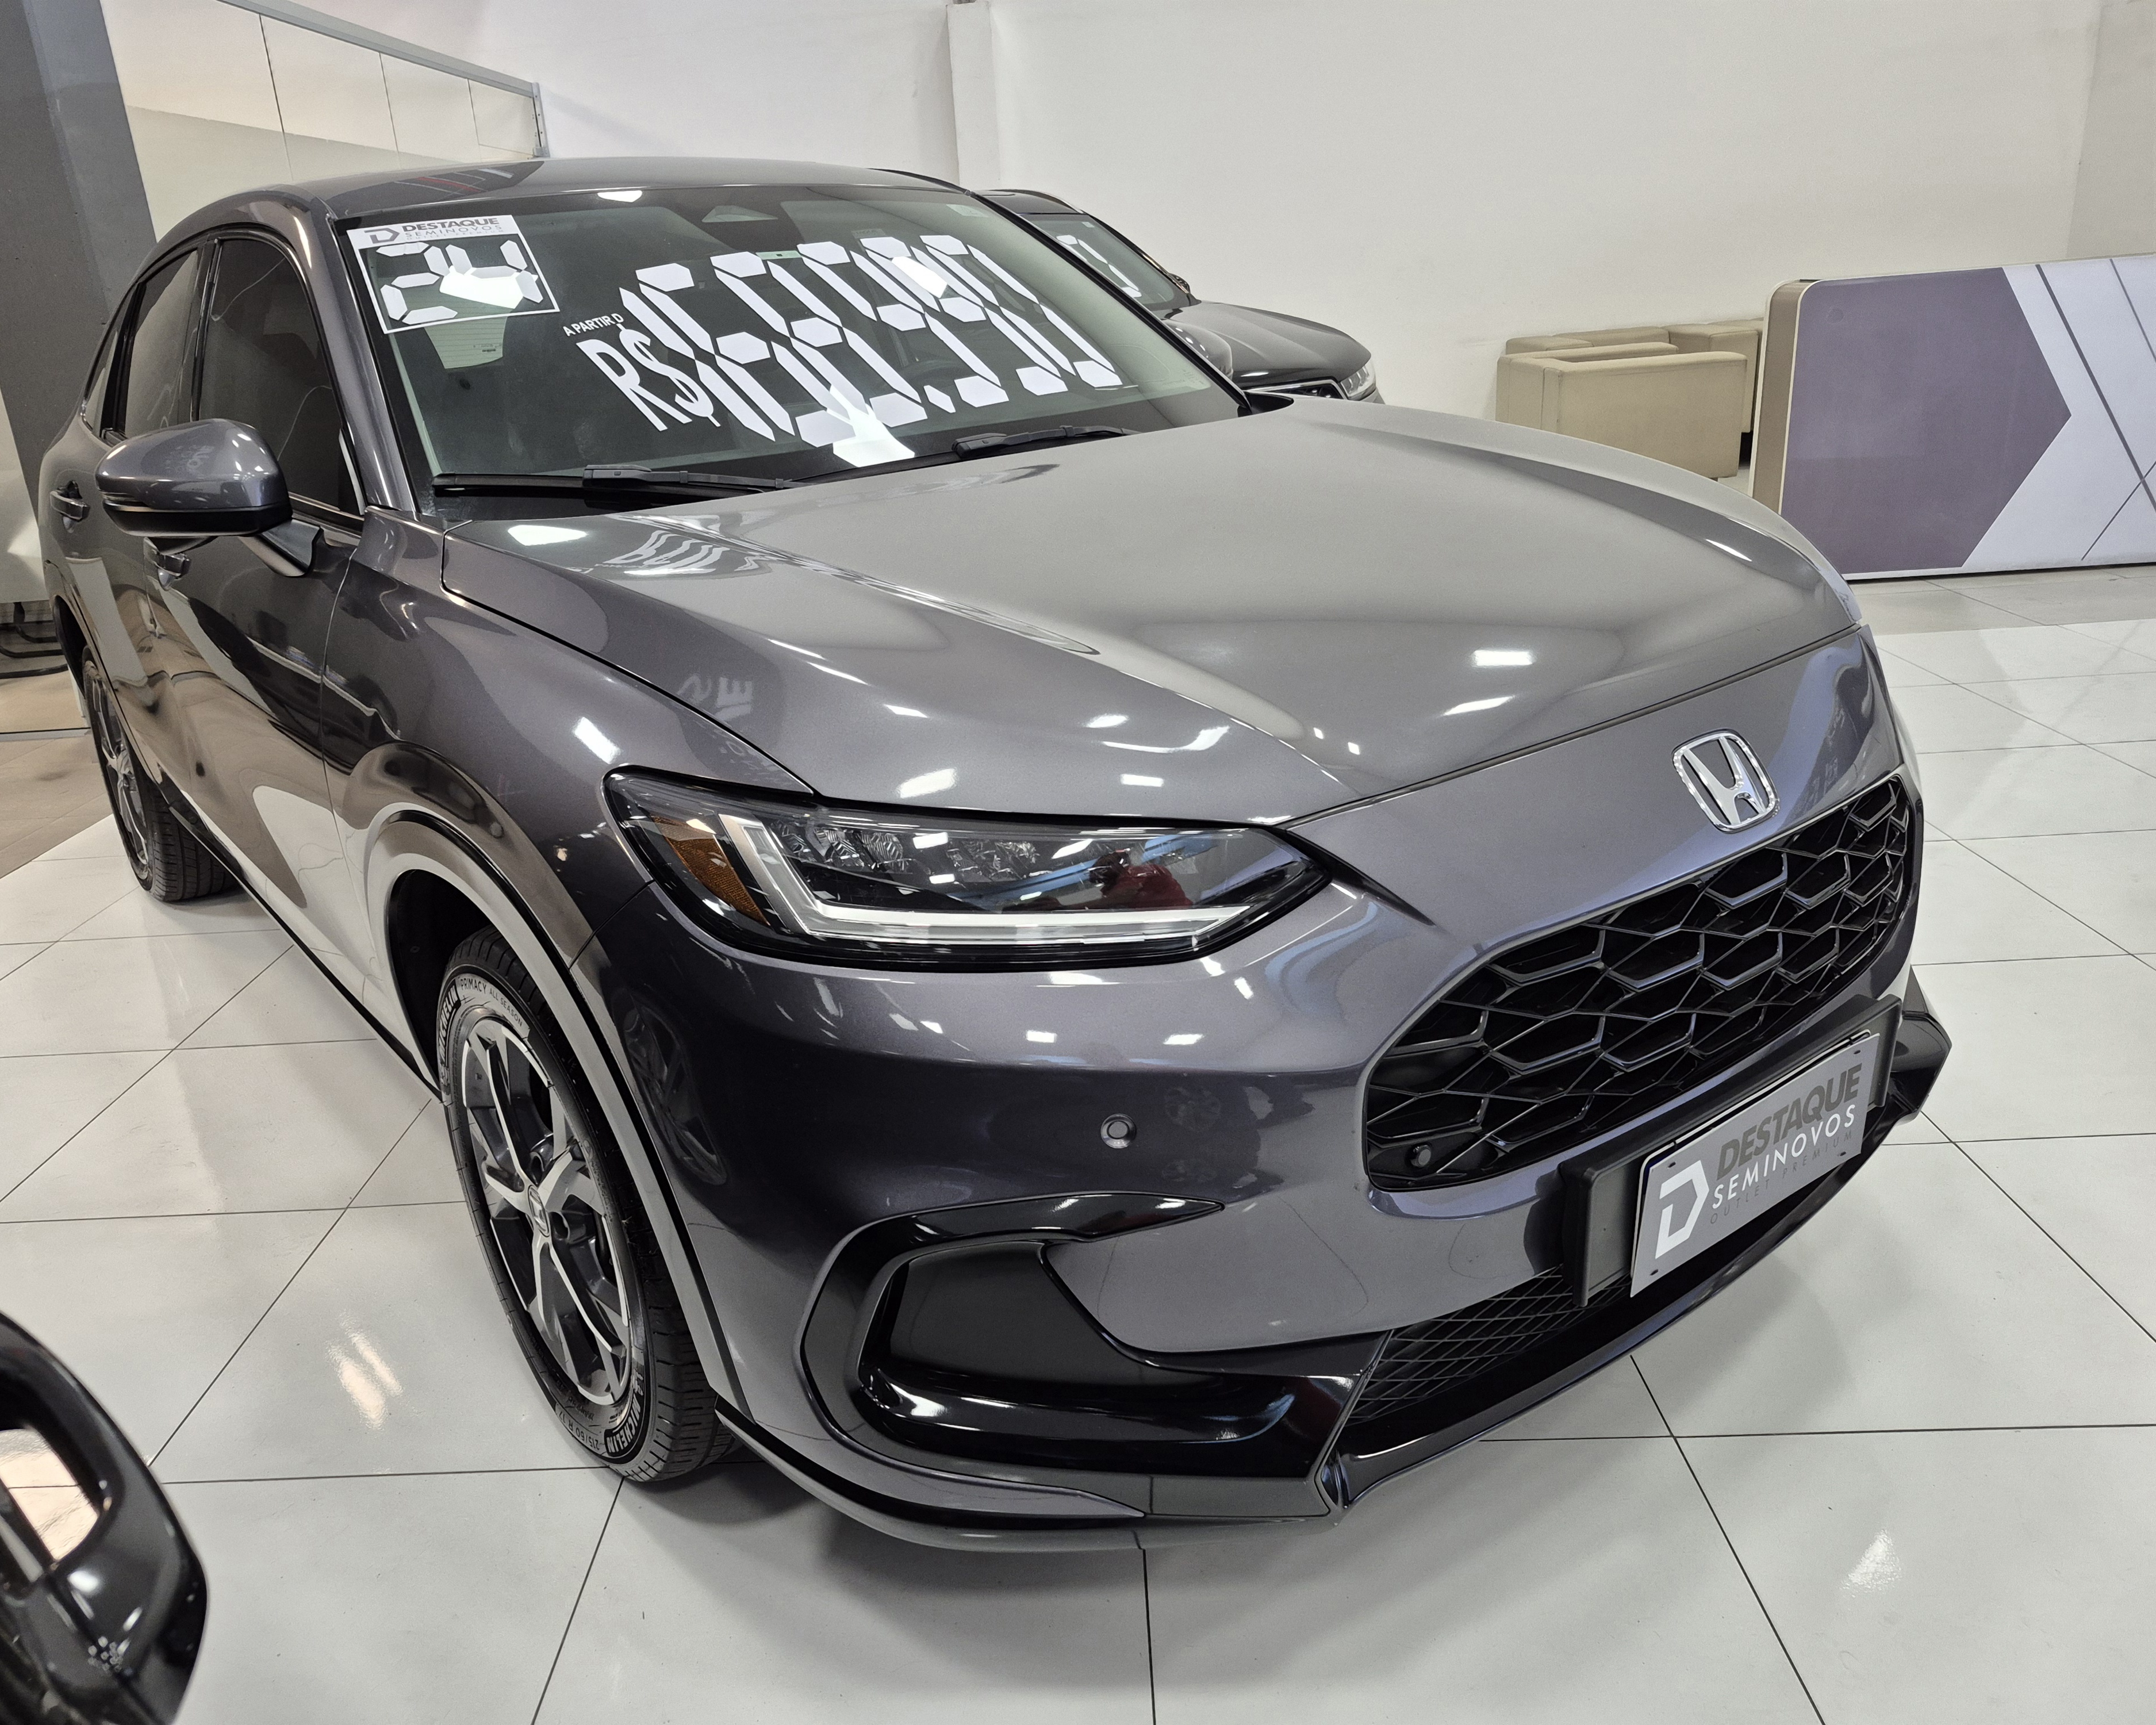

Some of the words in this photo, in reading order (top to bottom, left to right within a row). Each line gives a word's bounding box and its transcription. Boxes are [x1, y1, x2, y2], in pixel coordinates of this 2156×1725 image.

[401, 217, 500, 232] DESTAQUE
[405, 225, 502, 237] SEMINOVOS
[376, 240, 543, 325] 24
[562, 325, 577, 337] A
[570, 315, 616, 334] PARTIR
[576, 323, 721, 432] R$
[438, 984, 459, 1063] MICHELIN
[460, 978, 487, 994] PRIMACY
[489, 987, 500, 1001] ALL
[500, 998, 523, 1028] SEASON
[1716, 1063, 1862, 1180] DESTAQUE
[1710, 1179, 1770, 1224] OUTLET
[1782, 1130, 1852, 1179] PREMIUM
[1712, 1104, 1856, 1209] SEMINOVOS
[558, 1410, 566, 1424] 17
[568, 1420, 574, 1432] R
[576, 1427, 600, 1451] 215/60
[606, 1393, 641, 1453] MICHELIN
